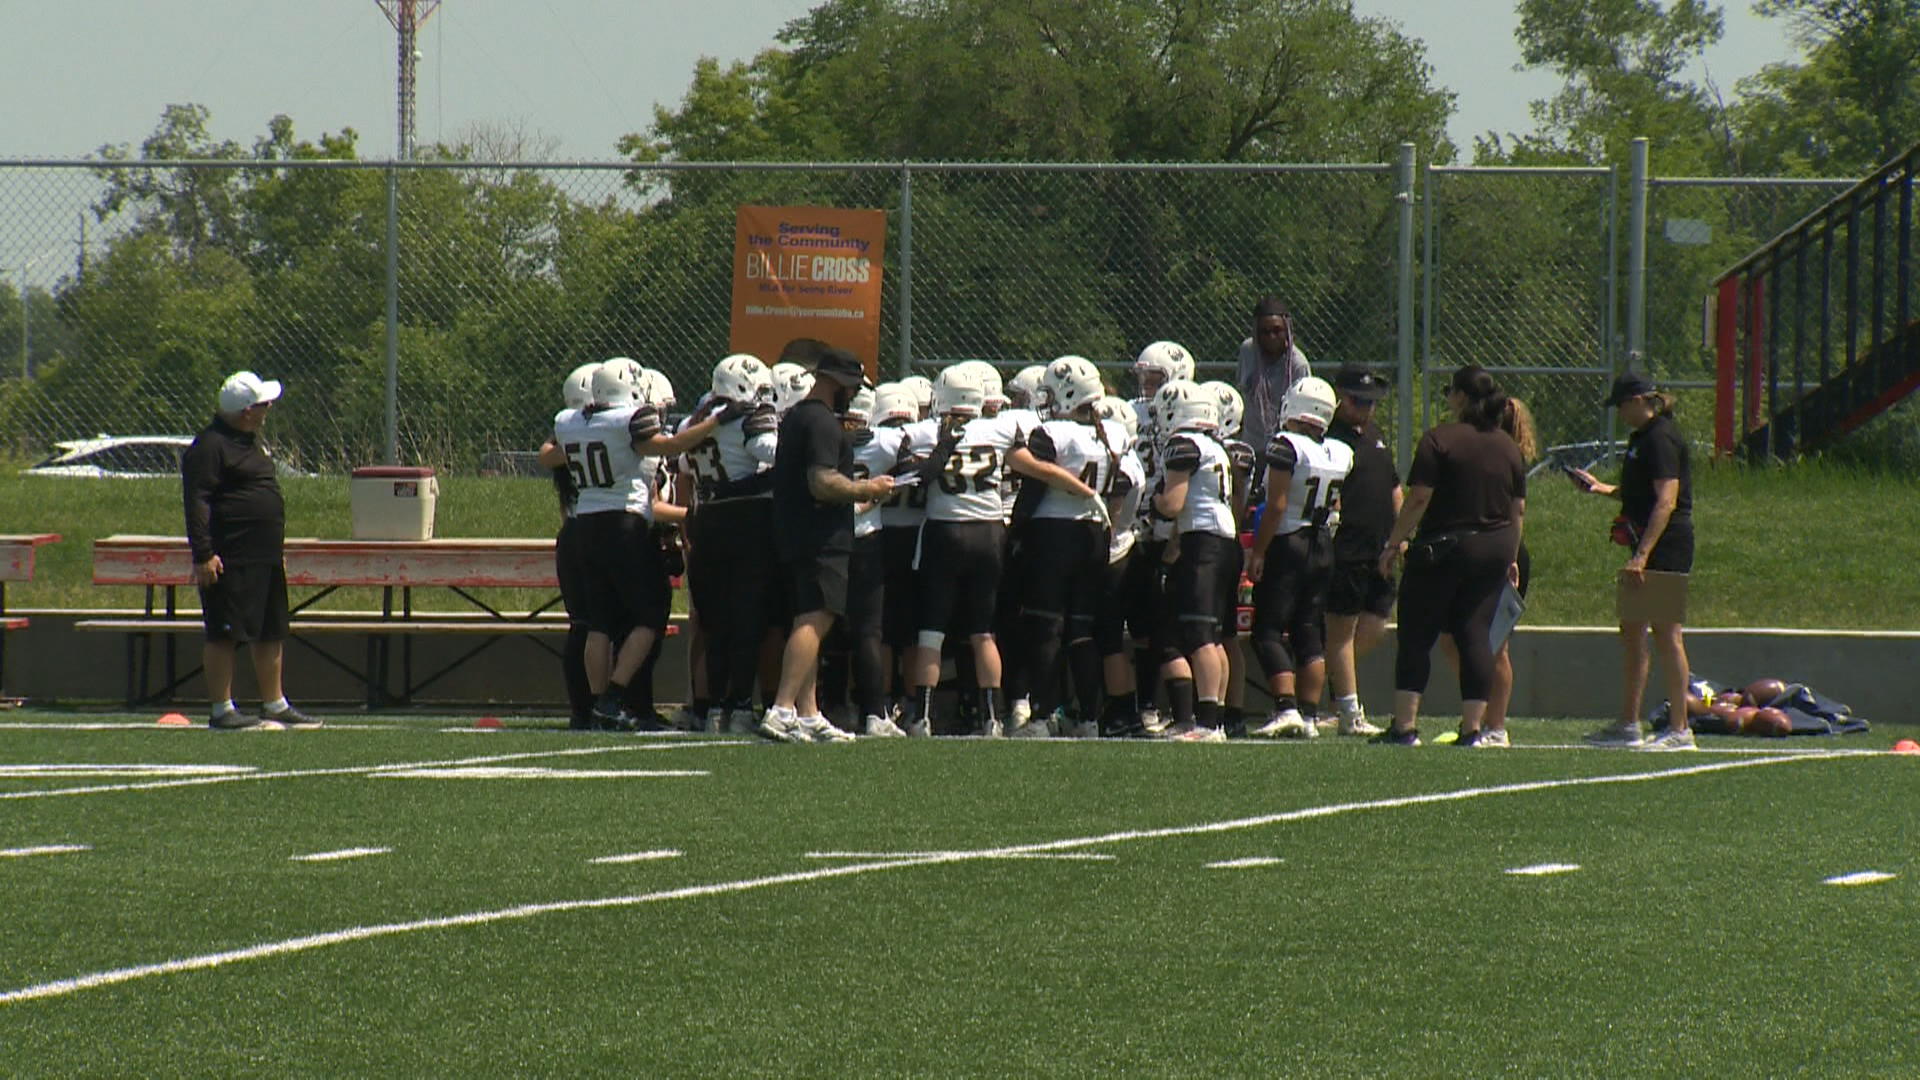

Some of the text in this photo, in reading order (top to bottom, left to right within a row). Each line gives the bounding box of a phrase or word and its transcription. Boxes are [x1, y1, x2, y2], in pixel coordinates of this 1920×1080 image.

[779, 221, 840, 237] Serving
[748, 234, 870, 251] the Community
[746, 253, 870, 283] BILLIE CROSS
[564, 441, 616, 488] 50
